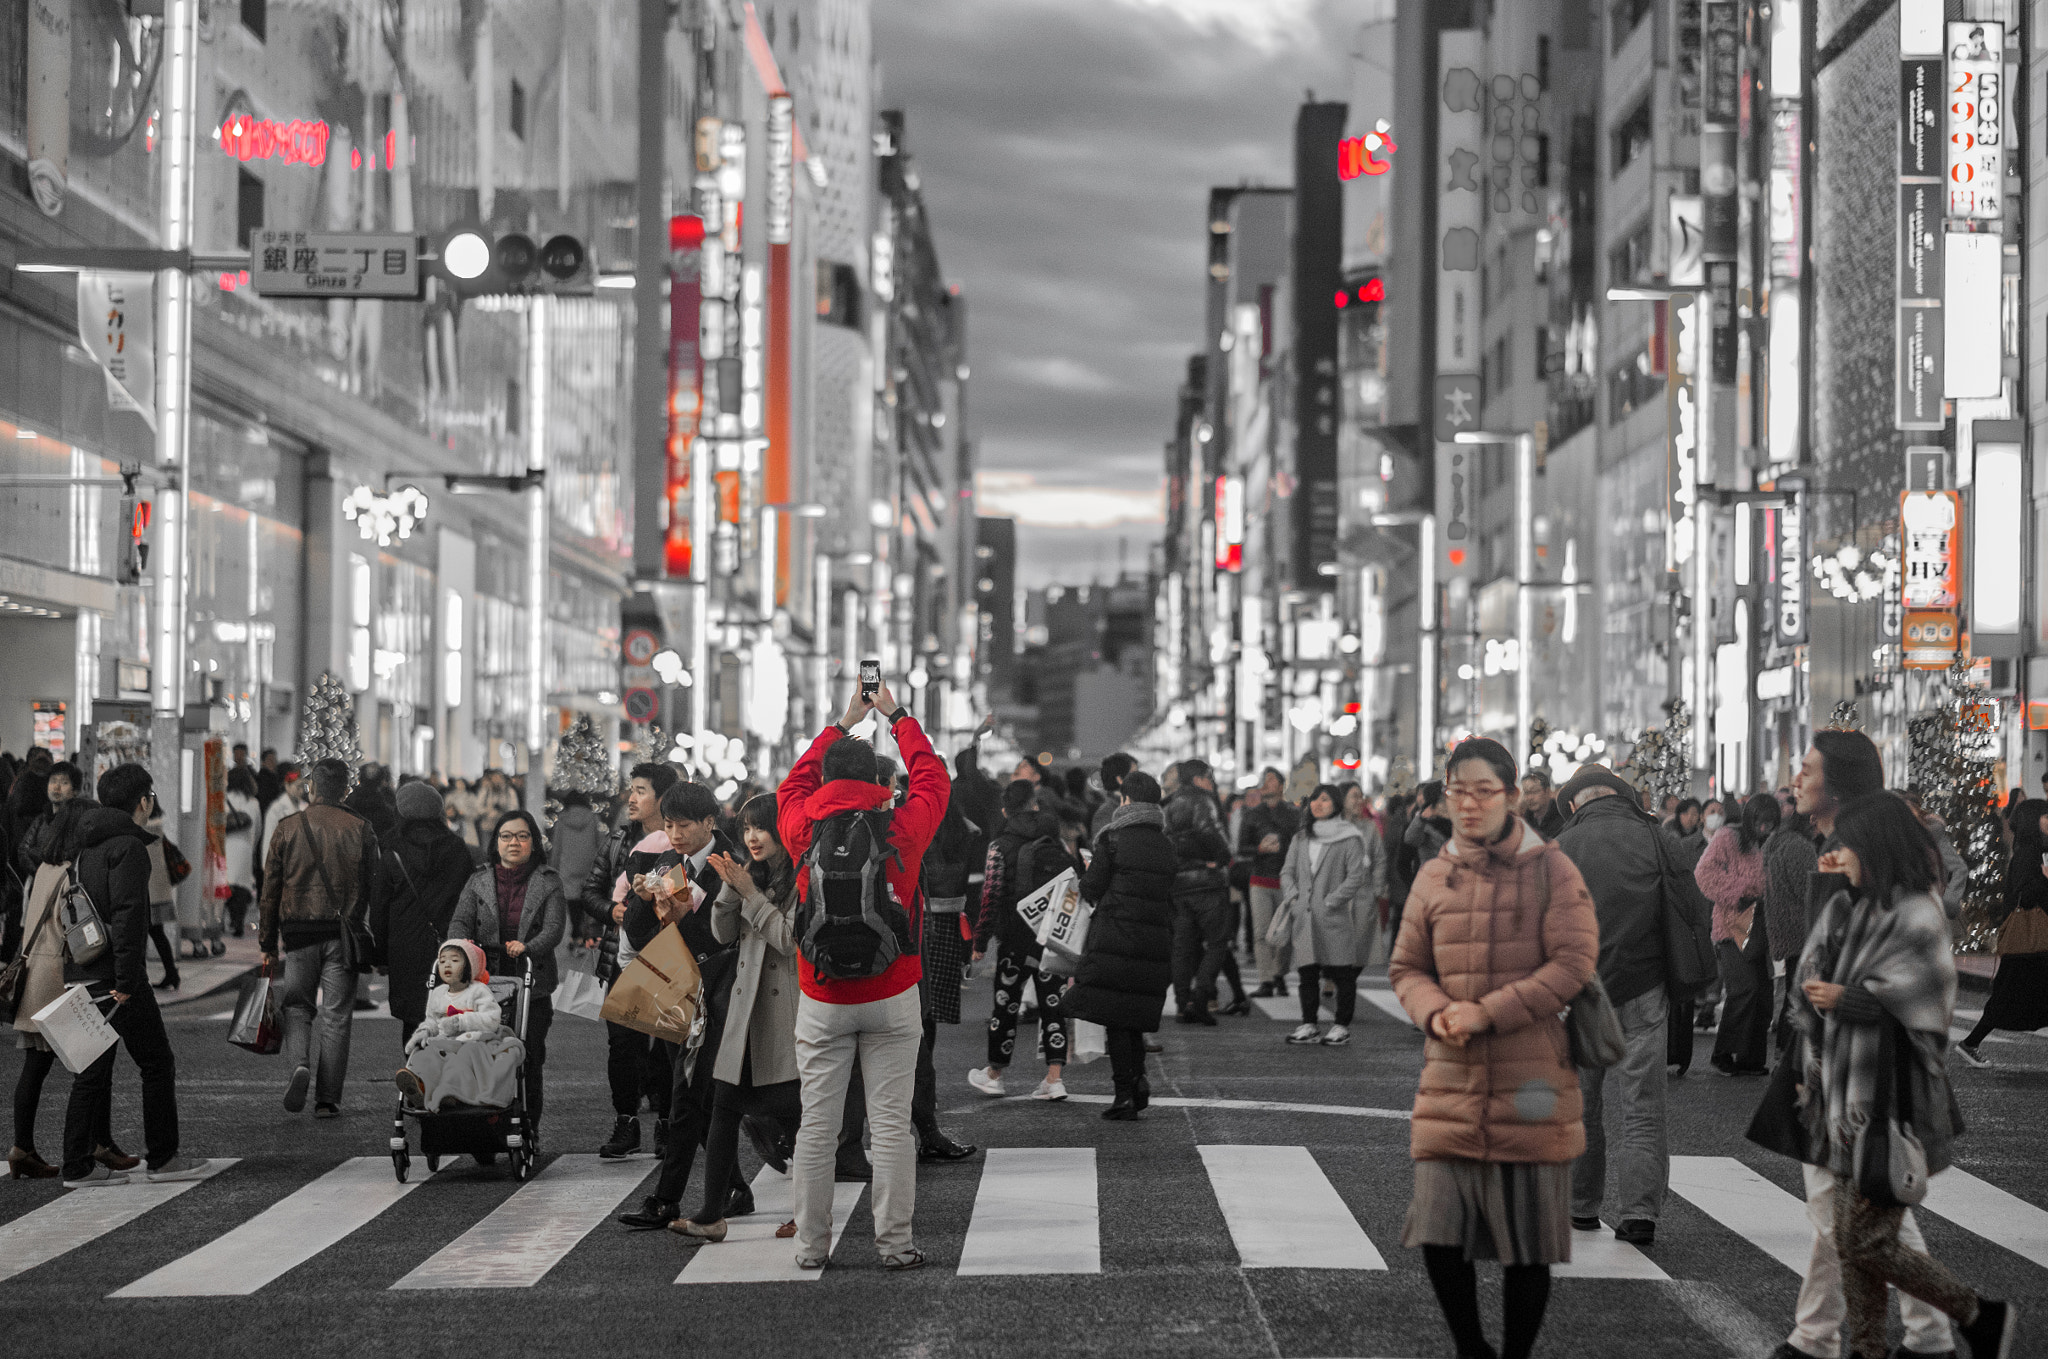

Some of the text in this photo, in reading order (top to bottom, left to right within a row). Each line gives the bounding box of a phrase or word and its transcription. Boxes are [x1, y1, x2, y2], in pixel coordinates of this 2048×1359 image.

[263, 246, 406, 275] 銀座二丁目
[306, 274, 362, 289] Ginza 2
